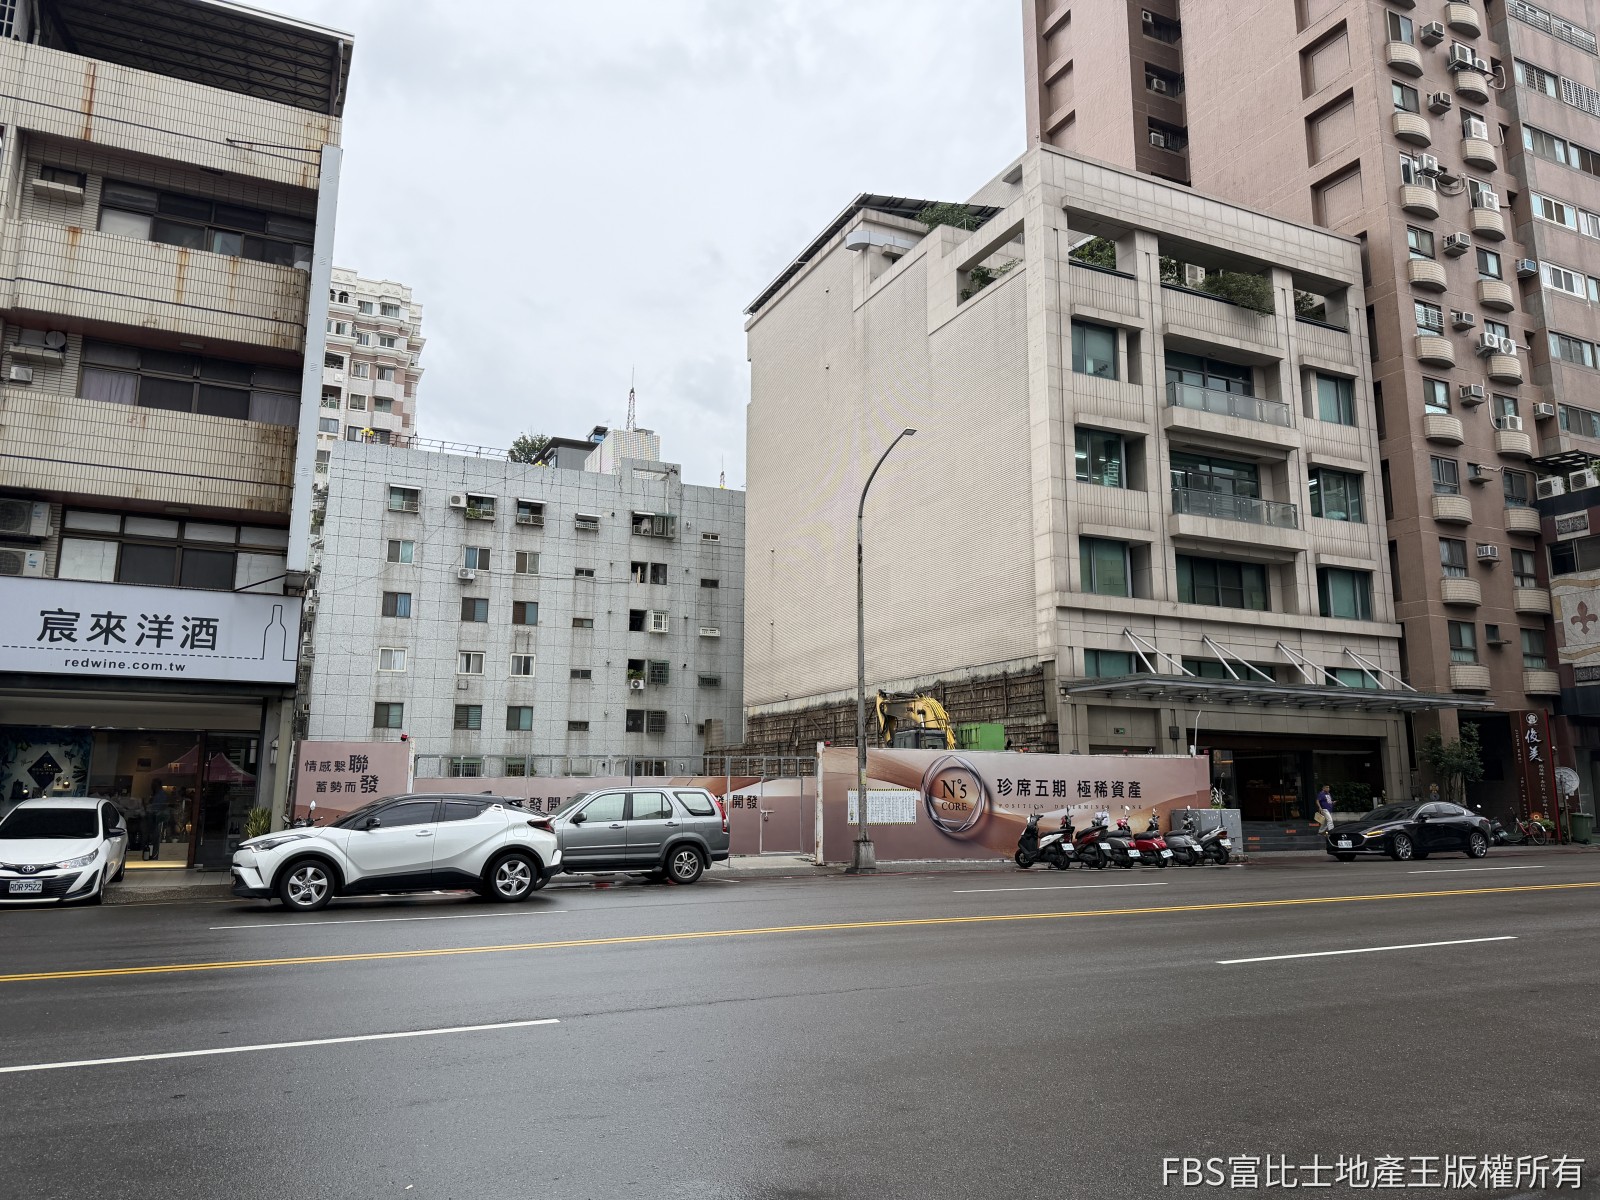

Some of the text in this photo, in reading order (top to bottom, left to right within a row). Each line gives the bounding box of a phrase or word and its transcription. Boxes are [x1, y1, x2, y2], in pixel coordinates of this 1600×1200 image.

[37, 608, 219, 650] 宸來洋酒
[64, 657, 186, 672] redwine.com.tw
[304, 755, 368, 773] 情感繫聯
[316, 775, 379, 793] 蓄勢而發
[997, 778, 1142, 799] 珍席五期 極稀資產
[529, 796, 572, 812] 發開
[941, 802, 968, 811] CORE
